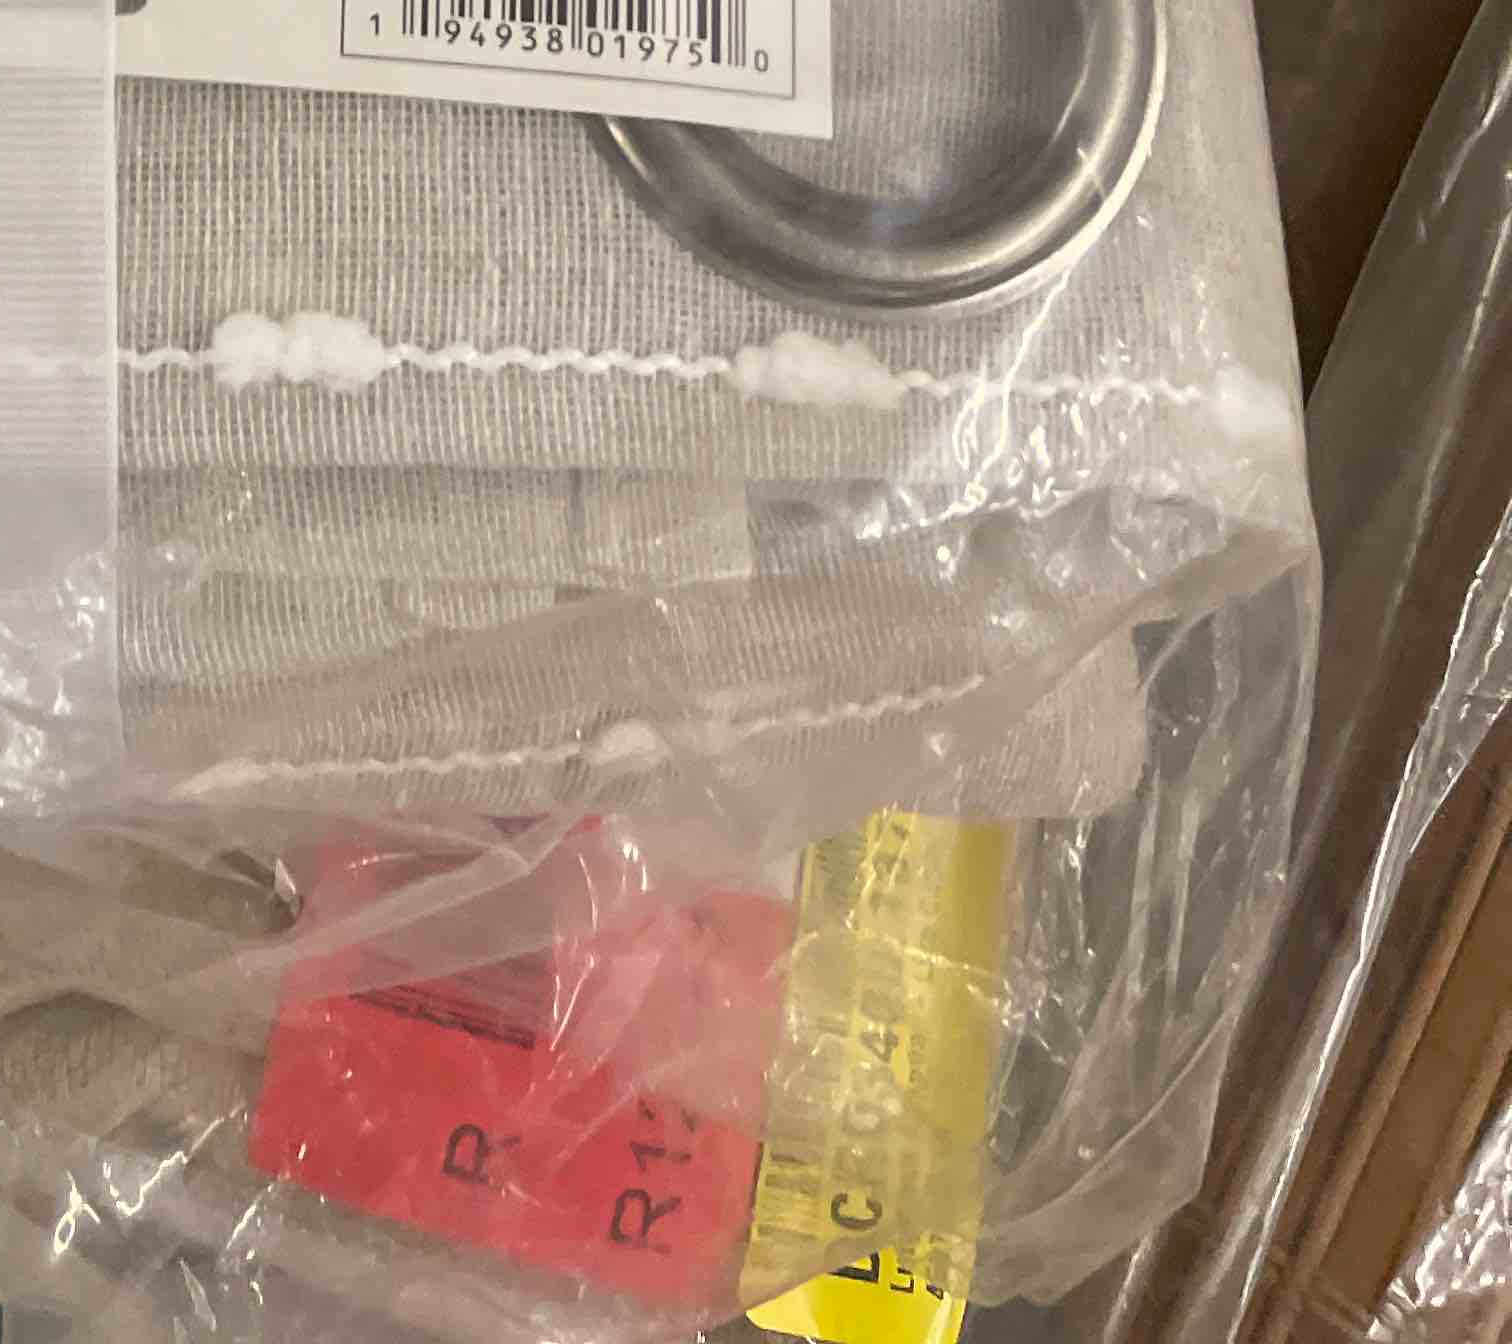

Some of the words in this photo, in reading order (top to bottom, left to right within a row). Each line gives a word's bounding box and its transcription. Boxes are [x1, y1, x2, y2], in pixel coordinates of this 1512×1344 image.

[369, 13, 381, 37] 1
[444, 20, 565, 55] 94938
[588, 30, 703, 68] 01975
[754, 48, 770, 73] 0
